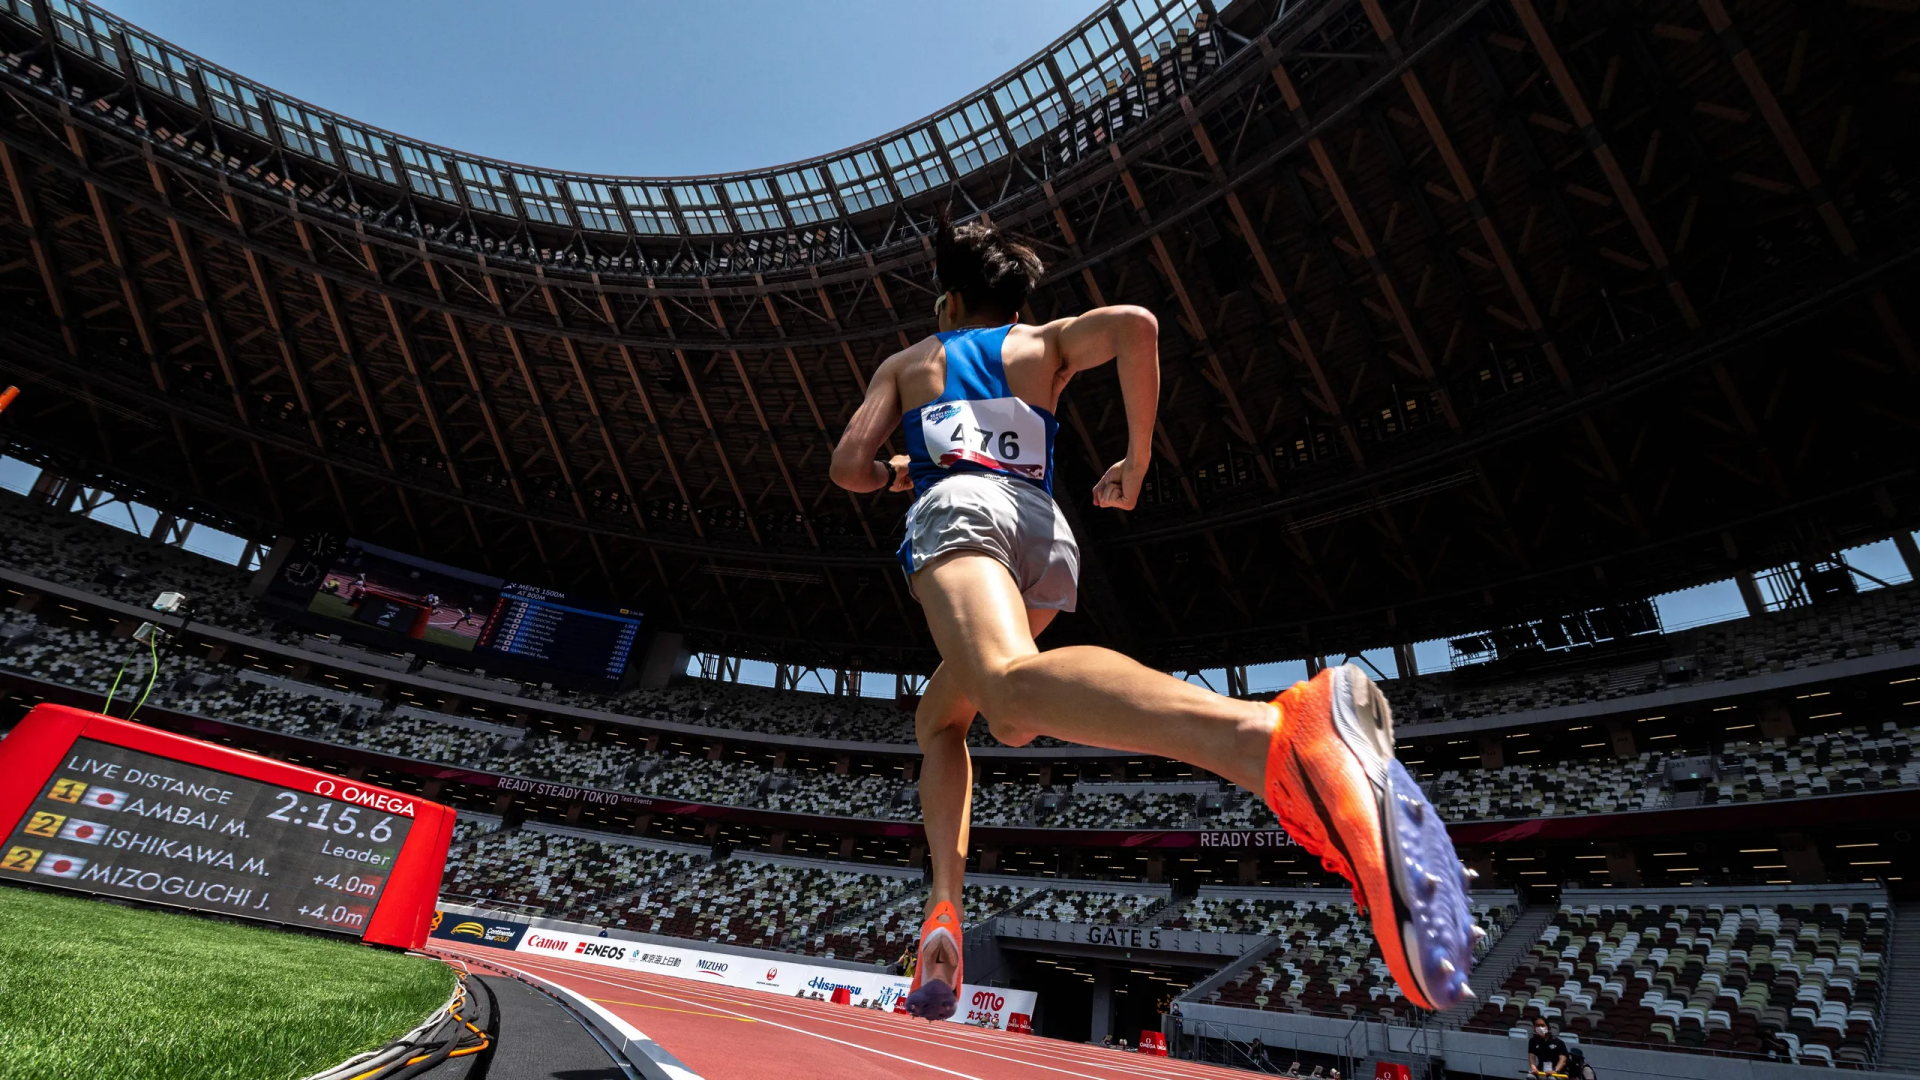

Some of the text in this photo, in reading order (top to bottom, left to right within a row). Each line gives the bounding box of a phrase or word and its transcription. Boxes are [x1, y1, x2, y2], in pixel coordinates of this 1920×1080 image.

[950, 423, 1020, 460] 476
[518, 584, 564, 599] MEN'S 1500M
[526, 592, 546, 600] 800M
[67, 756, 233, 804] LIVE DISTANCE
[342, 787, 414, 816] OMEGA
[498, 777, 536, 794] READY
[536, 784, 580, 800] STEADY
[582, 790, 618, 806] TOKYO
[57, 783, 250, 838] 1 AMBAI M.
[266, 792, 394, 842] 2:15.6
[34, 816, 270, 877] 2 ISHIKAWA M.
[1200, 832, 1303, 847] READY STEA
[322, 840, 390, 866] Leader
[10, 850, 270, 911] 2 MIZOGUCHI J.
[313, 874, 376, 896] +4.0m
[298, 904, 362, 926] +4.0m
[528, 934, 568, 952] Canon
[1089, 927, 1159, 948] GATE 5
[584, 943, 626, 960] ENEOS
[640, 953, 682, 968] 東京海上日動
[696, 958, 728, 972] MIZUHO
